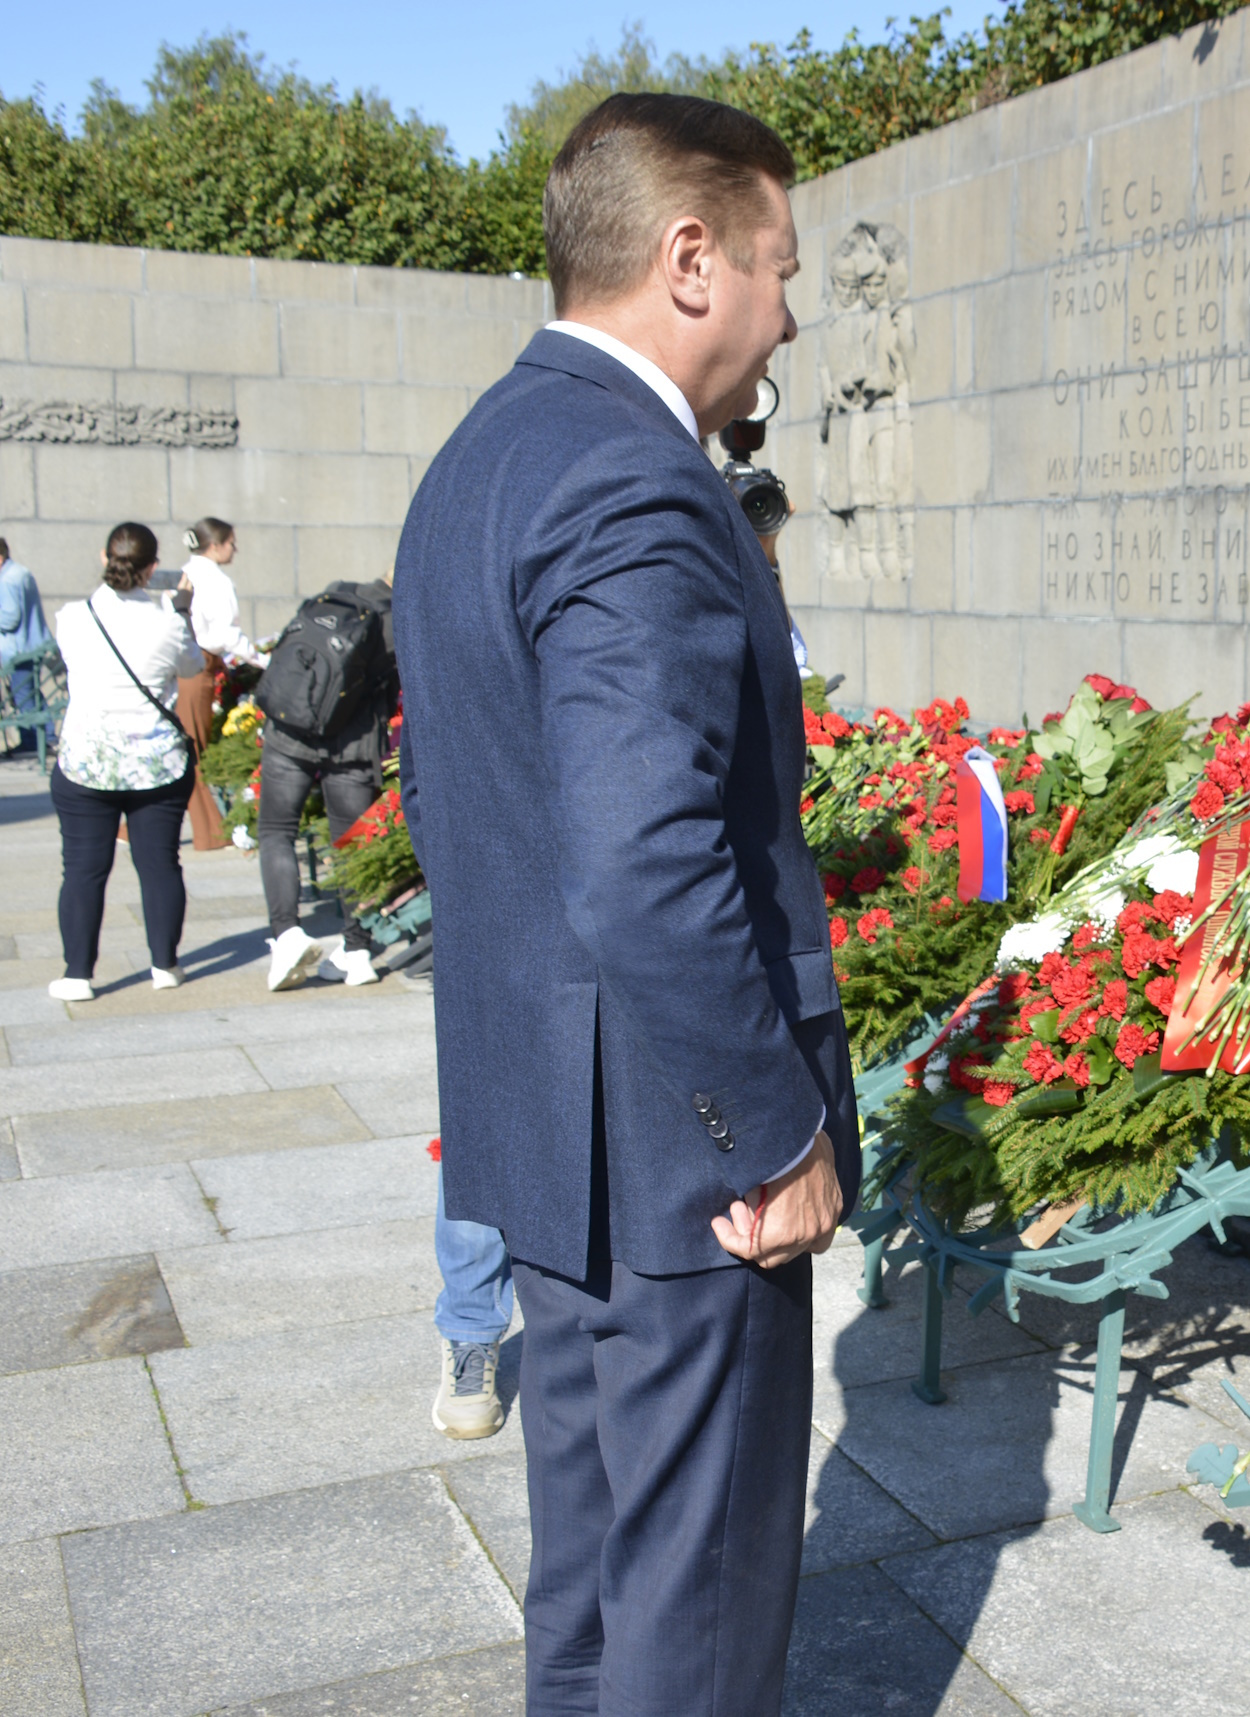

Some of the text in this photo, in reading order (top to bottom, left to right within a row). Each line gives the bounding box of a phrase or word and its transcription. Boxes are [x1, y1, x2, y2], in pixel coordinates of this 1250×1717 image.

[1056, 175, 1162, 238] ЗДЕСЬ
[1055, 237, 1119, 279] ЗДЕСЬ
[1053, 279, 1127, 319] РЯДОМ
[1144, 269, 1157, 301] С
[1132, 300, 1219, 345] ВСЕЮ
[1053, 361, 1115, 405] ОНИ
[1047, 456, 1068, 482] ИХ
[1073, 451, 1122, 479] ИМЕН
[1047, 531, 1078, 561] НО
[1047, 571, 1130, 602] НИКТО
[1149, 572, 1180, 604] НЕ
